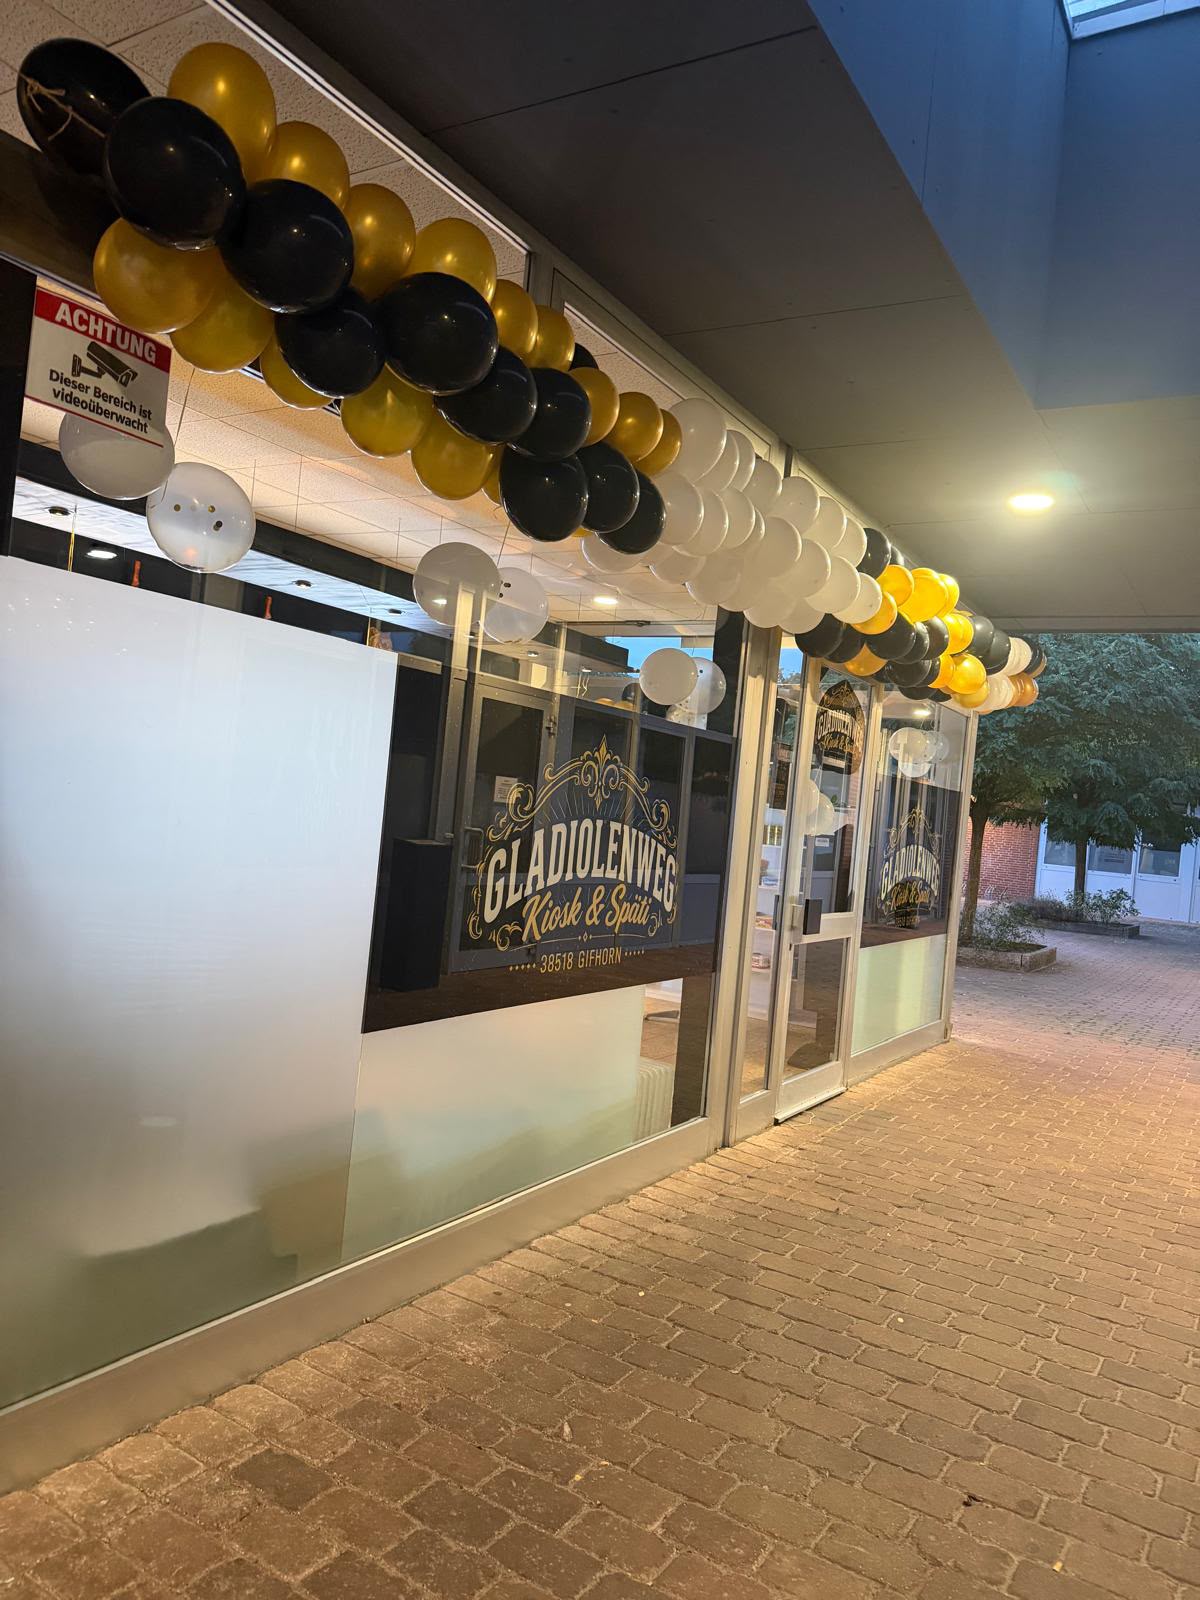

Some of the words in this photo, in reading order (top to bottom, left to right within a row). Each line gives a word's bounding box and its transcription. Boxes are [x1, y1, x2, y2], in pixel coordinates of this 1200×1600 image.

[55, 302, 157, 364] ACHTUNG
[49, 368, 91, 394] Dieser
[93, 386, 137, 415] Bereich
[138, 405, 153, 421] ist
[52, 387, 149, 434] videoüberwacht
[483, 817, 677, 924] GLADIOLENWEG
[881, 844, 940, 901] GLADIOLENWEG
[521, 886, 583, 942] Kiosk
[585, 885, 605, 929] &
[605, 883, 653, 934] Späti
[540, 953, 574, 974] 38518
[578, 947, 622, 969] GIFHORN
